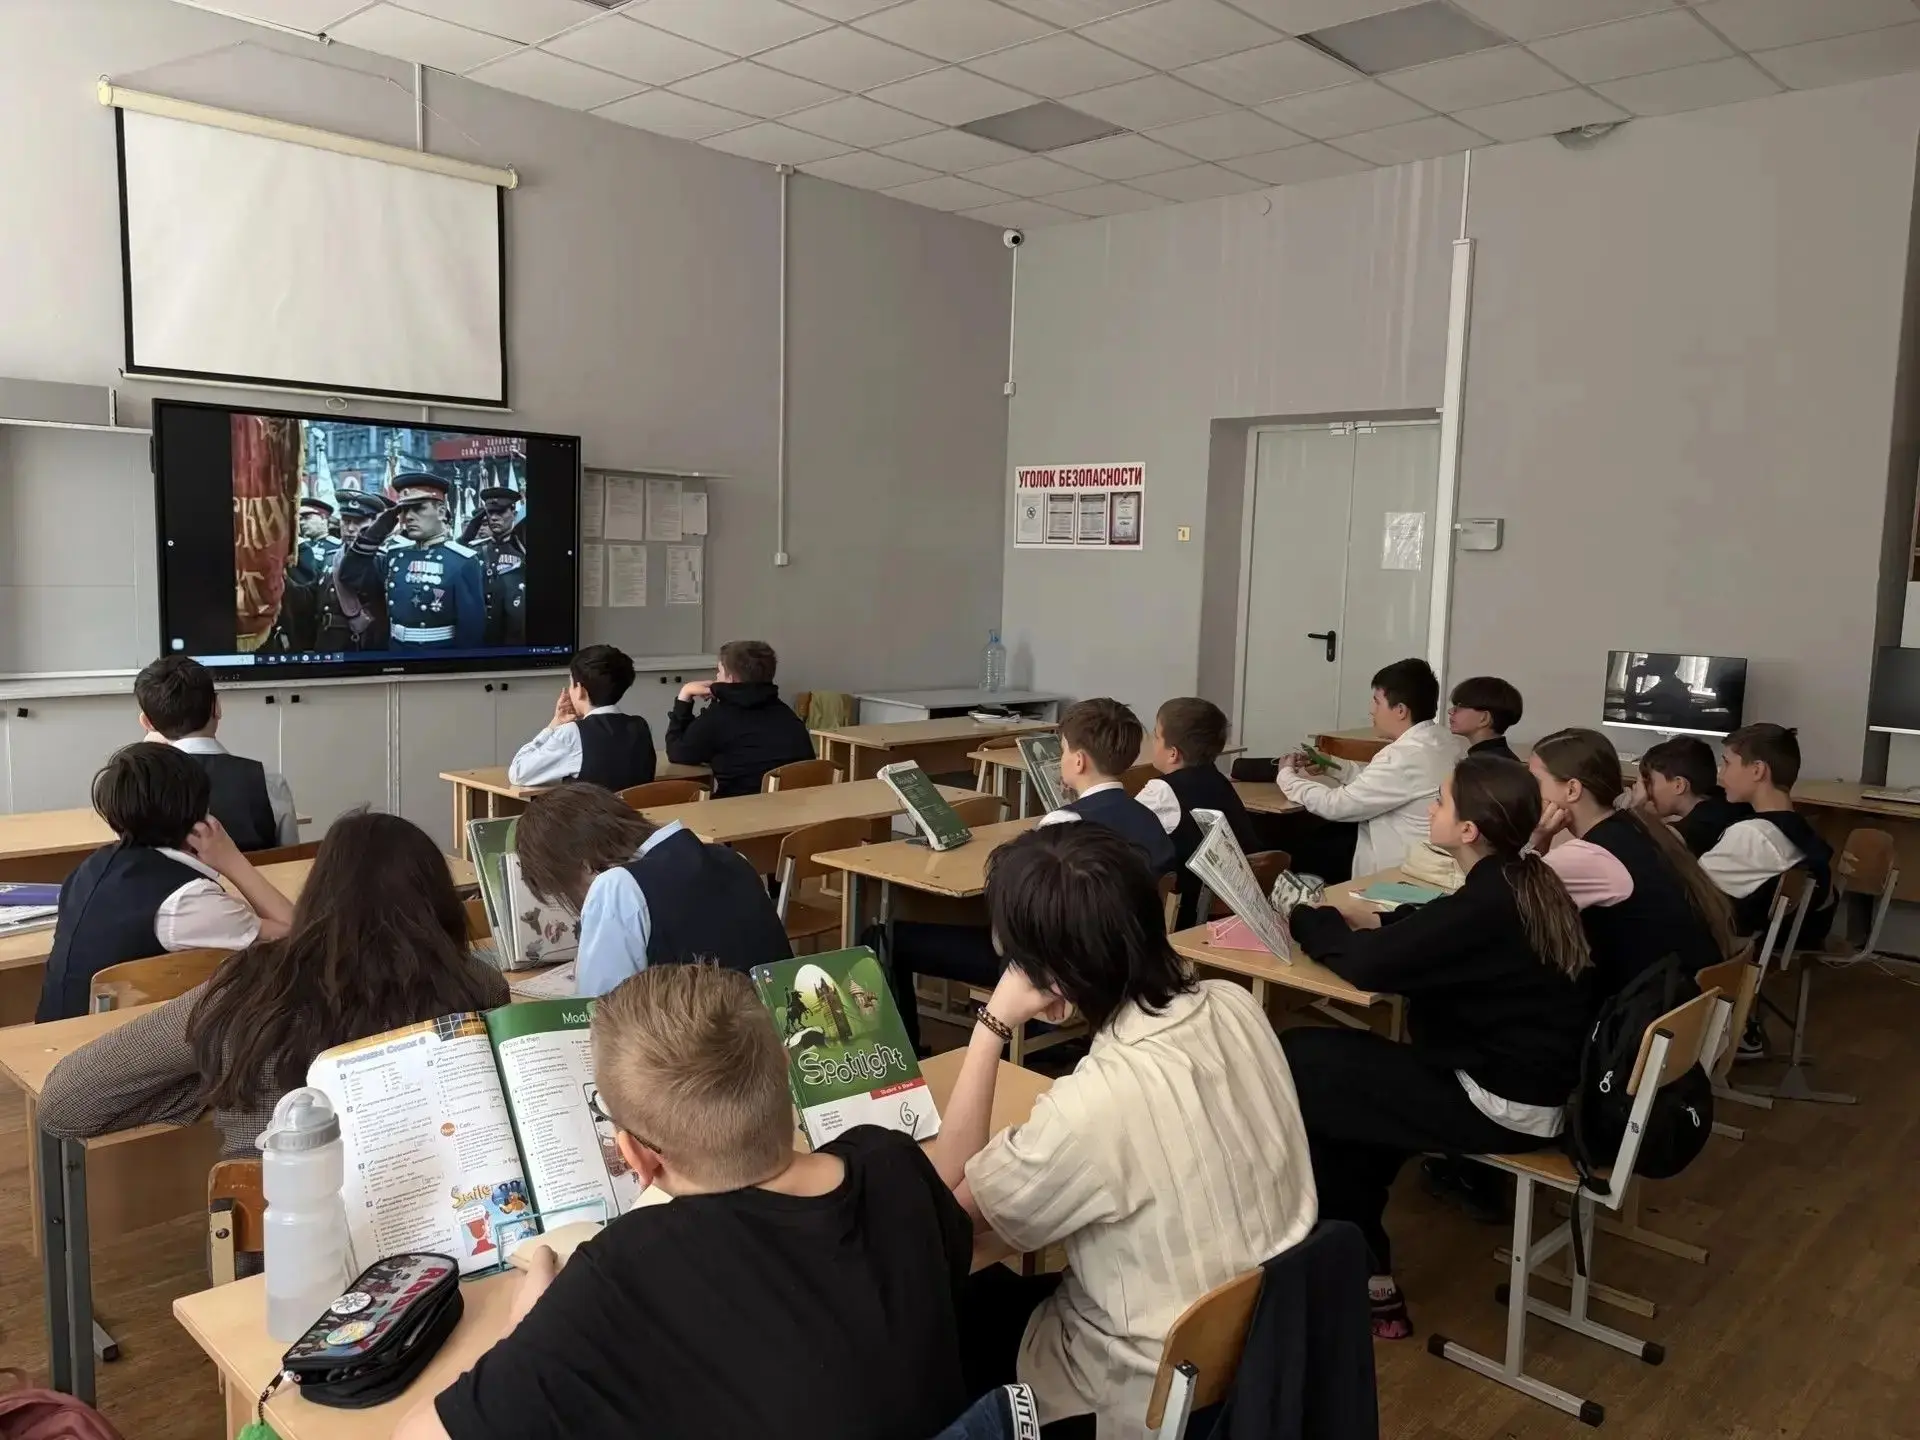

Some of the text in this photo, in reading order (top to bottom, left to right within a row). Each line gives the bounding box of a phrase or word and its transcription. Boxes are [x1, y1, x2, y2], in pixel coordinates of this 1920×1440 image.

[1019, 467, 1142, 488] УГОЛОК БЕЗОПАСНОСТИ
[562, 1011, 594, 1025] Modu
[798, 1043, 907, 1085] Spotlight
[900, 1101, 916, 1126] 6
[450, 1184, 491, 1209] Smile
[1012, 1385, 1035, 1440] NITE
